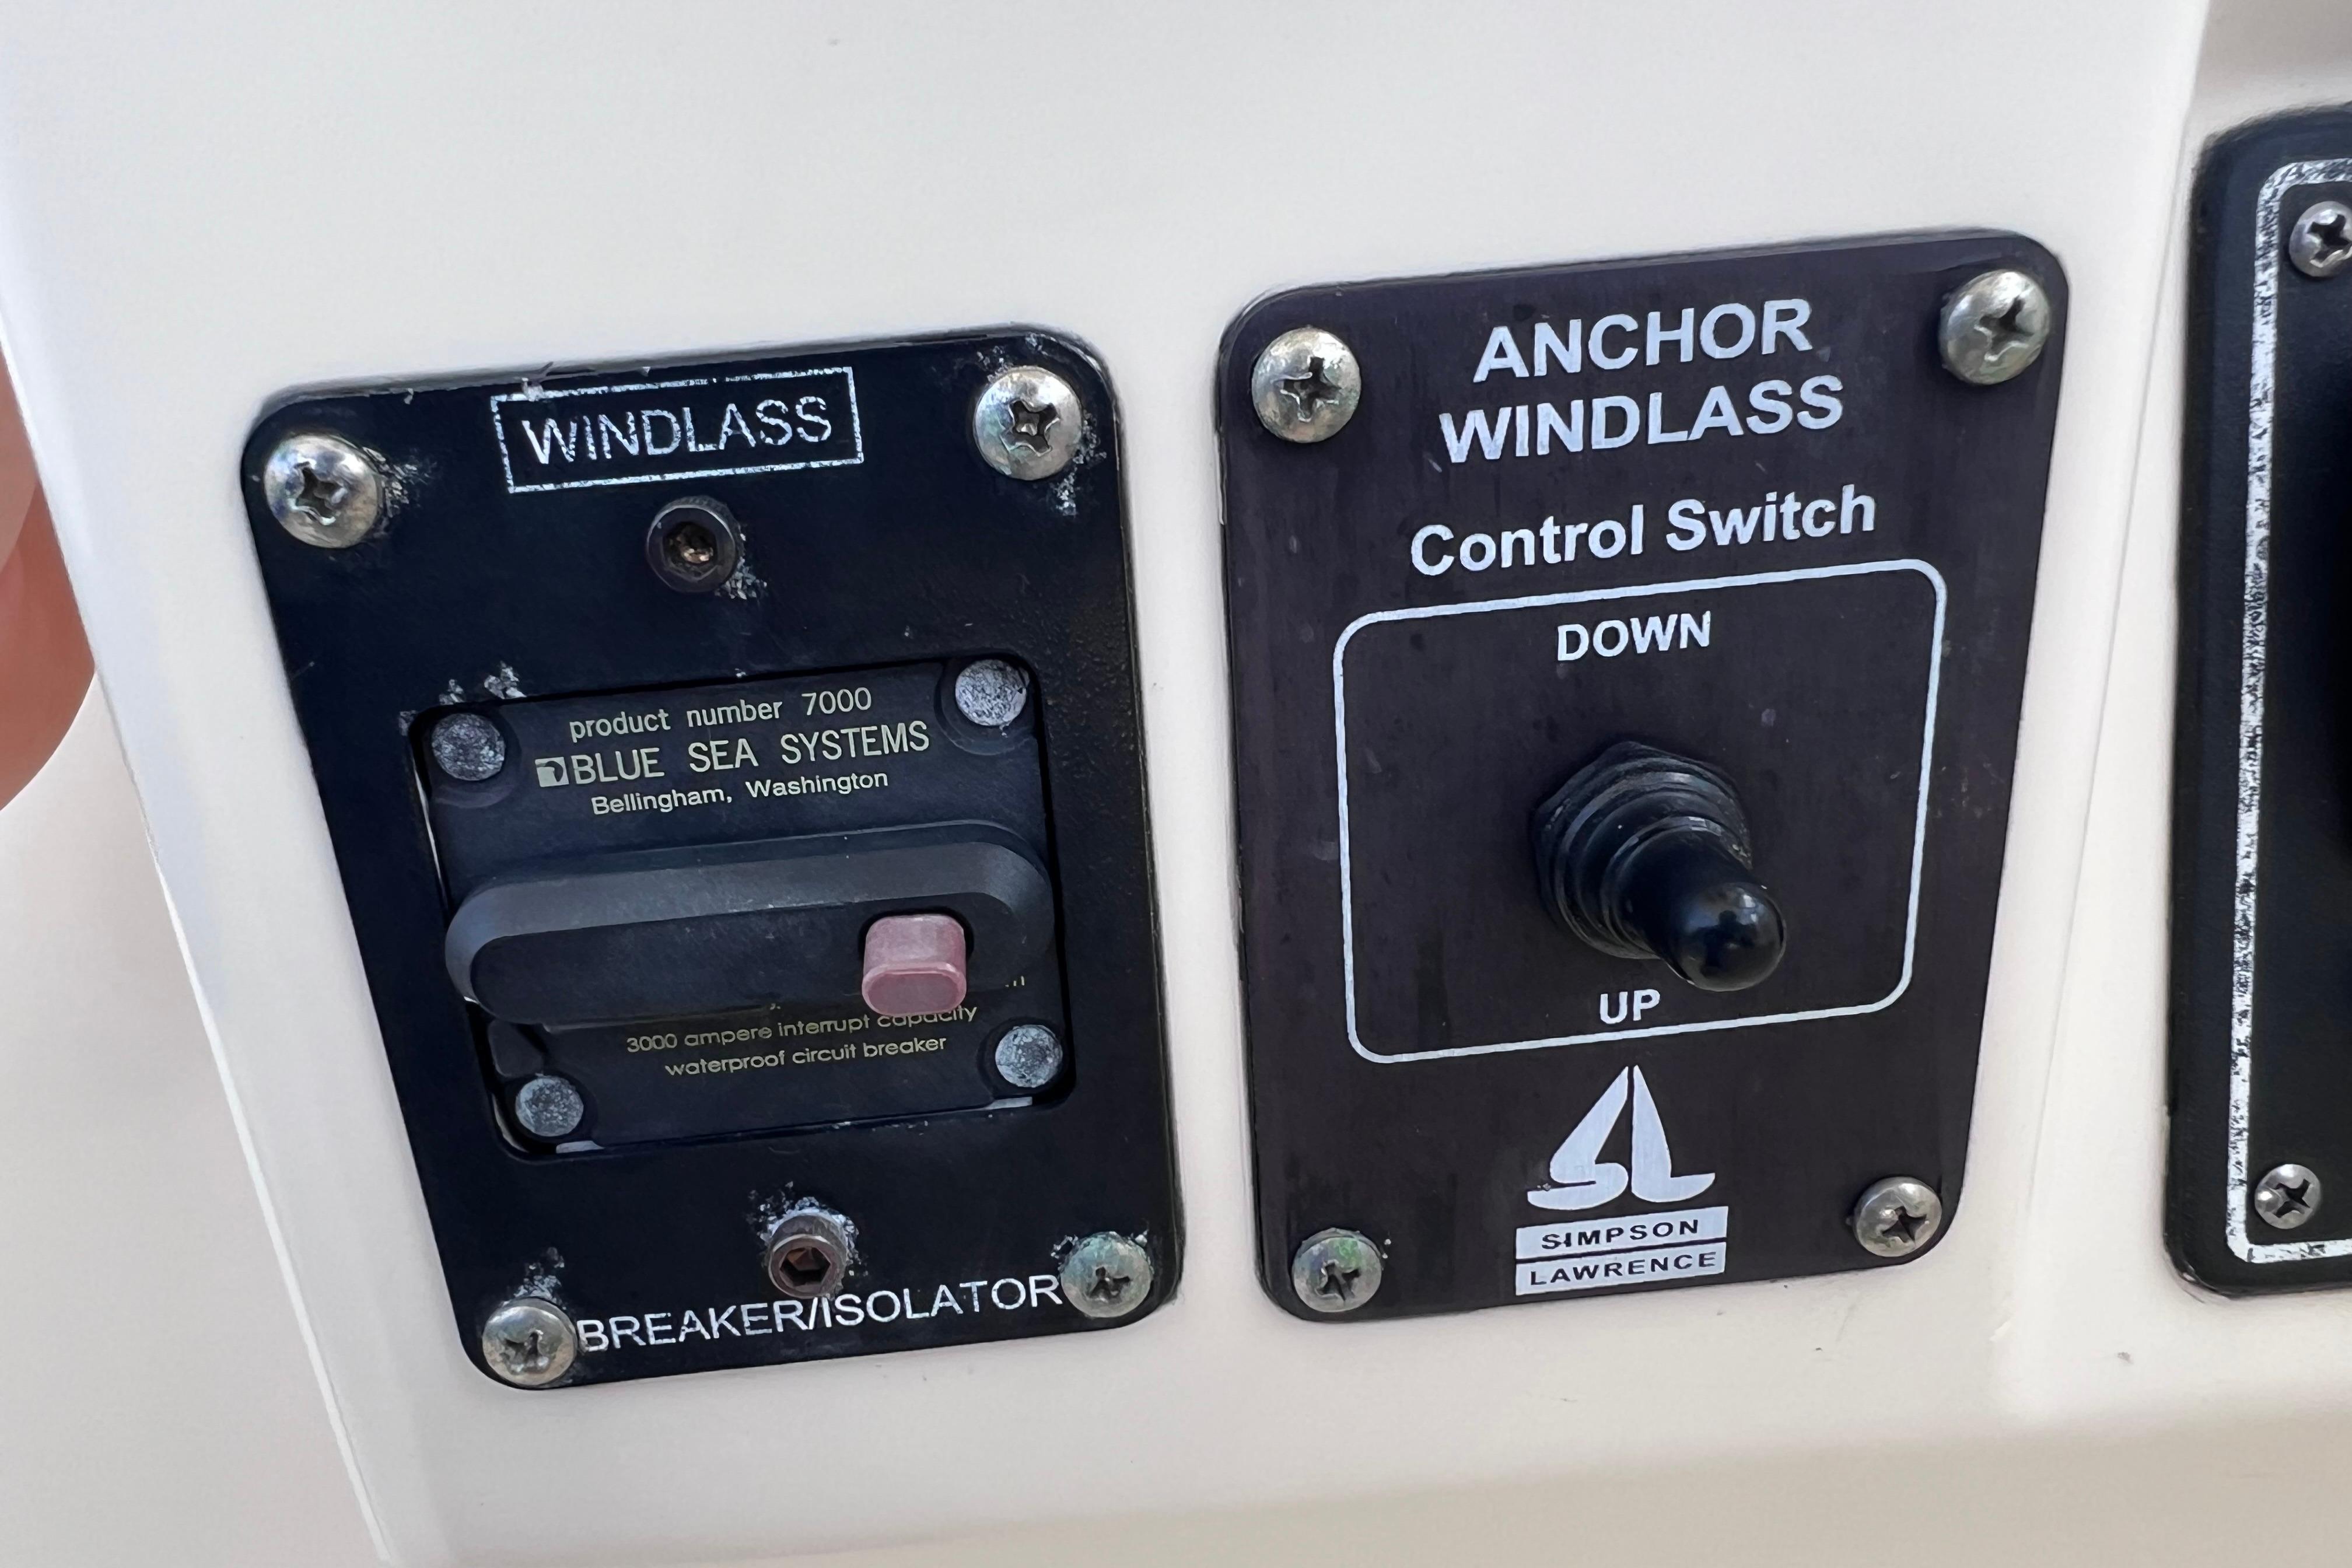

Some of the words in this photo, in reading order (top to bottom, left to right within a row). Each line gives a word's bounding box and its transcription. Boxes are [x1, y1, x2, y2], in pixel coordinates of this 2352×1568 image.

[1473, 298, 1813, 383] ANCHOR
[522, 396, 832, 464] WINDLASS
[1438, 375, 1844, 463] WINDLASS
[1410, 504, 1644, 576] Control
[1666, 484, 1876, 551] Switch
[1557, 610, 1712, 662] DOWN
[569, 708, 671, 742] product
[687, 699, 783, 727] number
[802, 687, 872, 716] 7000
[570, 747, 665, 785] BLUE
[689, 738, 758, 773] SEA
[780, 720, 930, 764] SYSTEMS
[592, 787, 733, 814] Bellingham,
[746, 771, 889, 798] Washington
[1600, 988, 1661, 1024] UP
[626, 1033, 678, 1052] 3000
[684, 1027, 772, 1046] ampere
[778, 1014, 870, 1037] interrupt
[664, 1050, 785, 1076] waterproof
[792, 1043, 856, 1064] circuit
[863, 1036, 947, 1058] breaker
[1541, 1219, 1699, 1250] SIMPSON
[1530, 1251, 1717, 1286] LAWRENCE
[577, 1273, 1063, 1353] BREAKER/ISOLATOR
